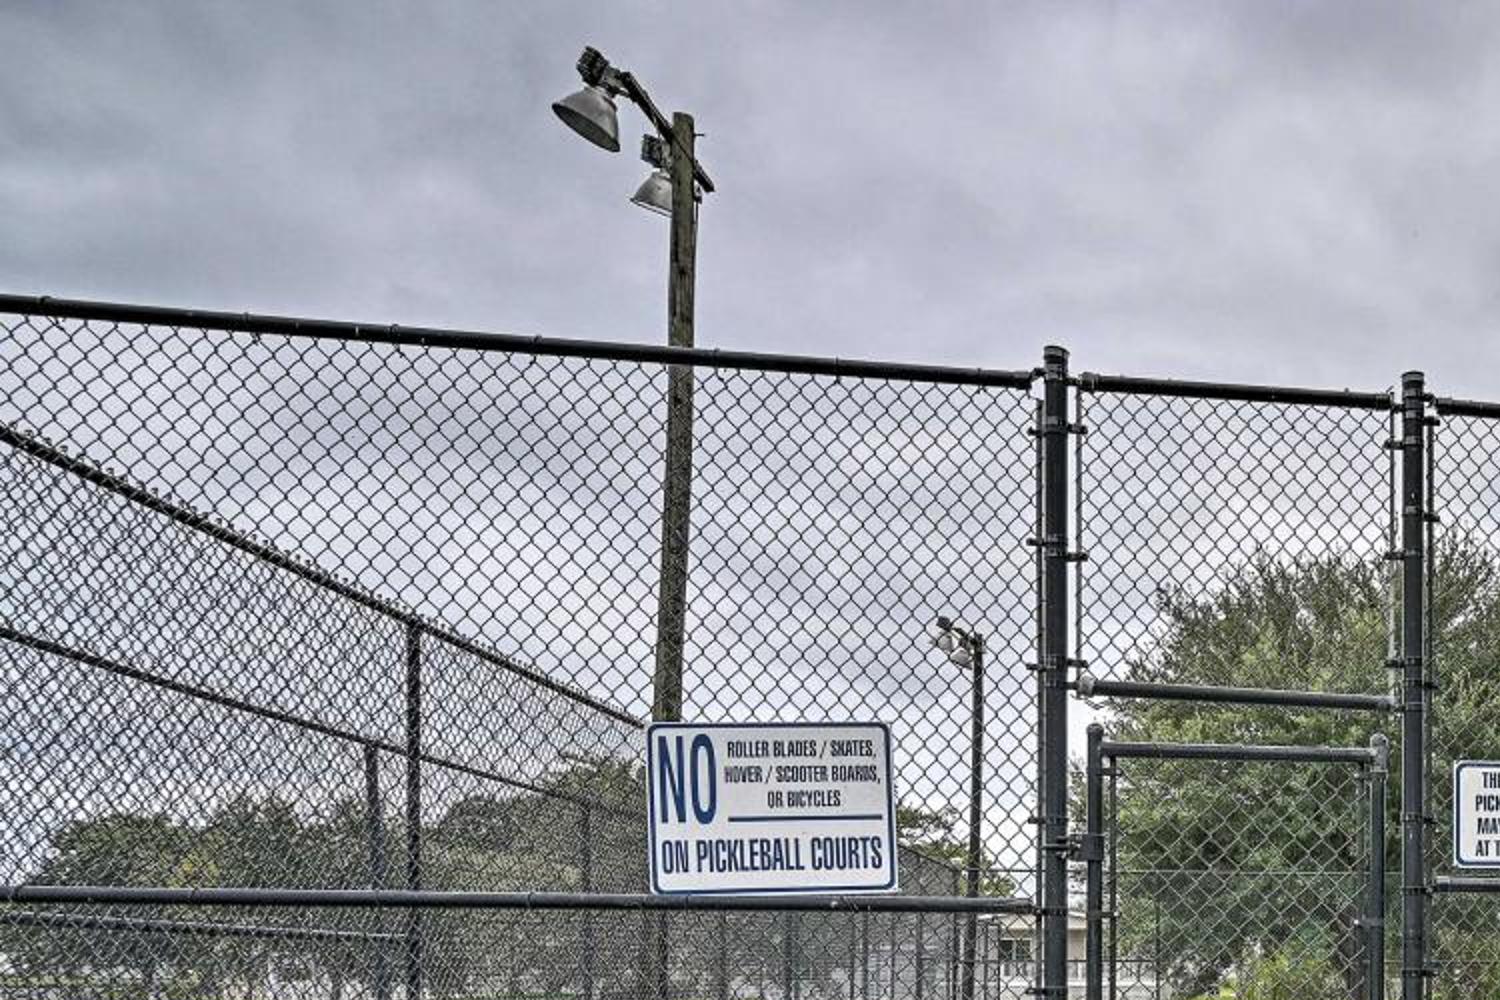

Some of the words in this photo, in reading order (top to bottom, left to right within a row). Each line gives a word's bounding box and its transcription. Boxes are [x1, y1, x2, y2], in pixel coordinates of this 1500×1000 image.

[728, 742, 769, 758] ROLLER
[774, 741, 816, 757] BLADES
[830, 740, 877, 757] SKATES,
[658, 734, 717, 824] NO
[725, 766, 763, 783] HOVER
[776, 766, 828, 782] SCOOTER
[831, 766, 880, 783] BOARDS,
[767, 791, 783, 808] OR
[788, 790, 841, 807] BICYCLES
[662, 840, 689, 874] ON
[696, 838, 805, 872] PICKLEBALL
[811, 837, 882, 870] COURTS
[1476, 840, 1490, 856] AT
